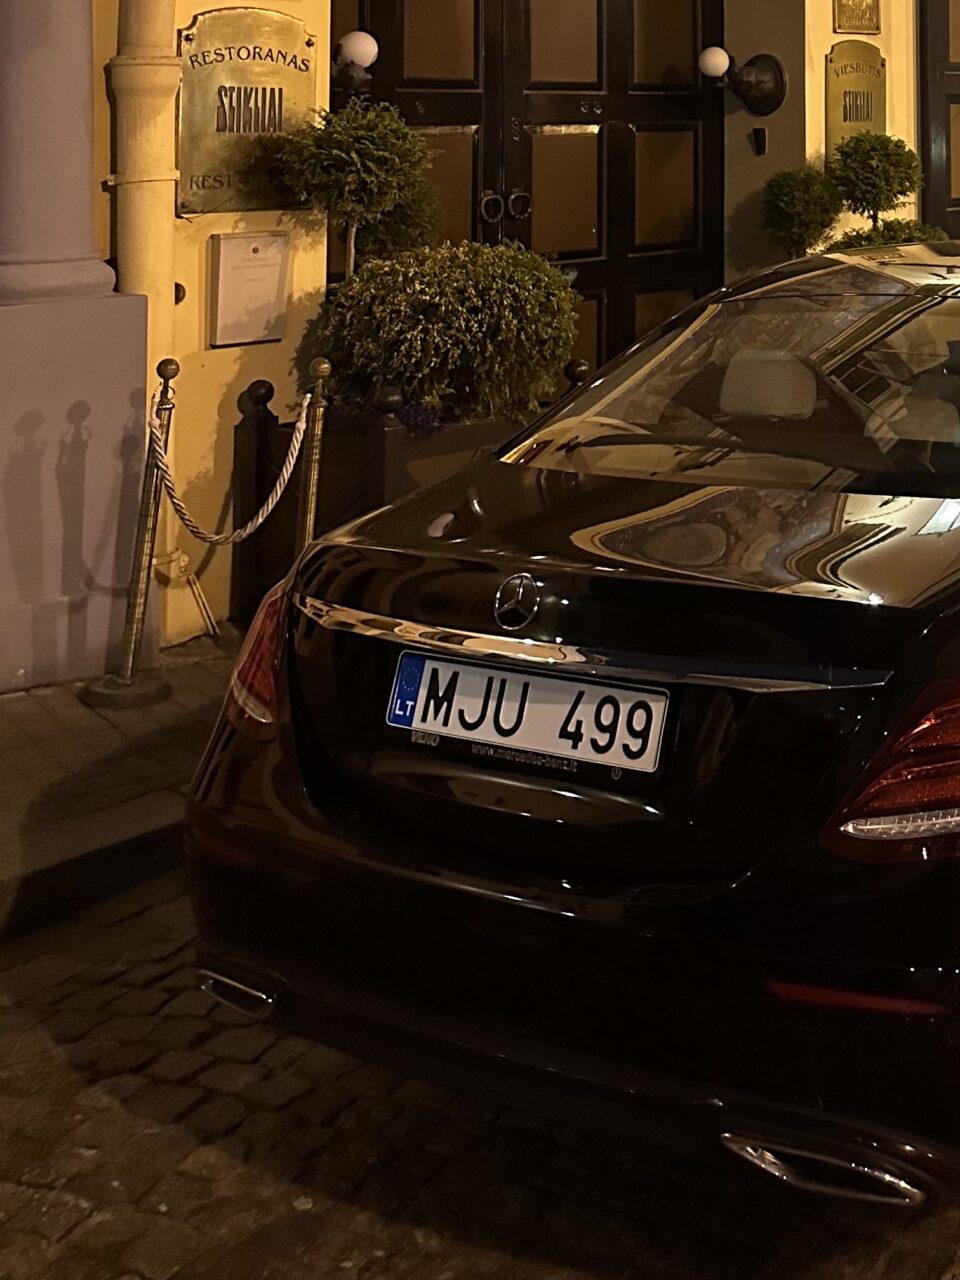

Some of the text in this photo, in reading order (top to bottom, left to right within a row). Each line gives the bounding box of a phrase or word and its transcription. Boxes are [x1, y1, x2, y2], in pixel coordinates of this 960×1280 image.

[189, 46, 310, 72] RESTORANAS
[216, 85, 283, 133] STIKLIAI
[395, 699, 414, 717] LT
[420, 668, 653, 760] MJU 499
